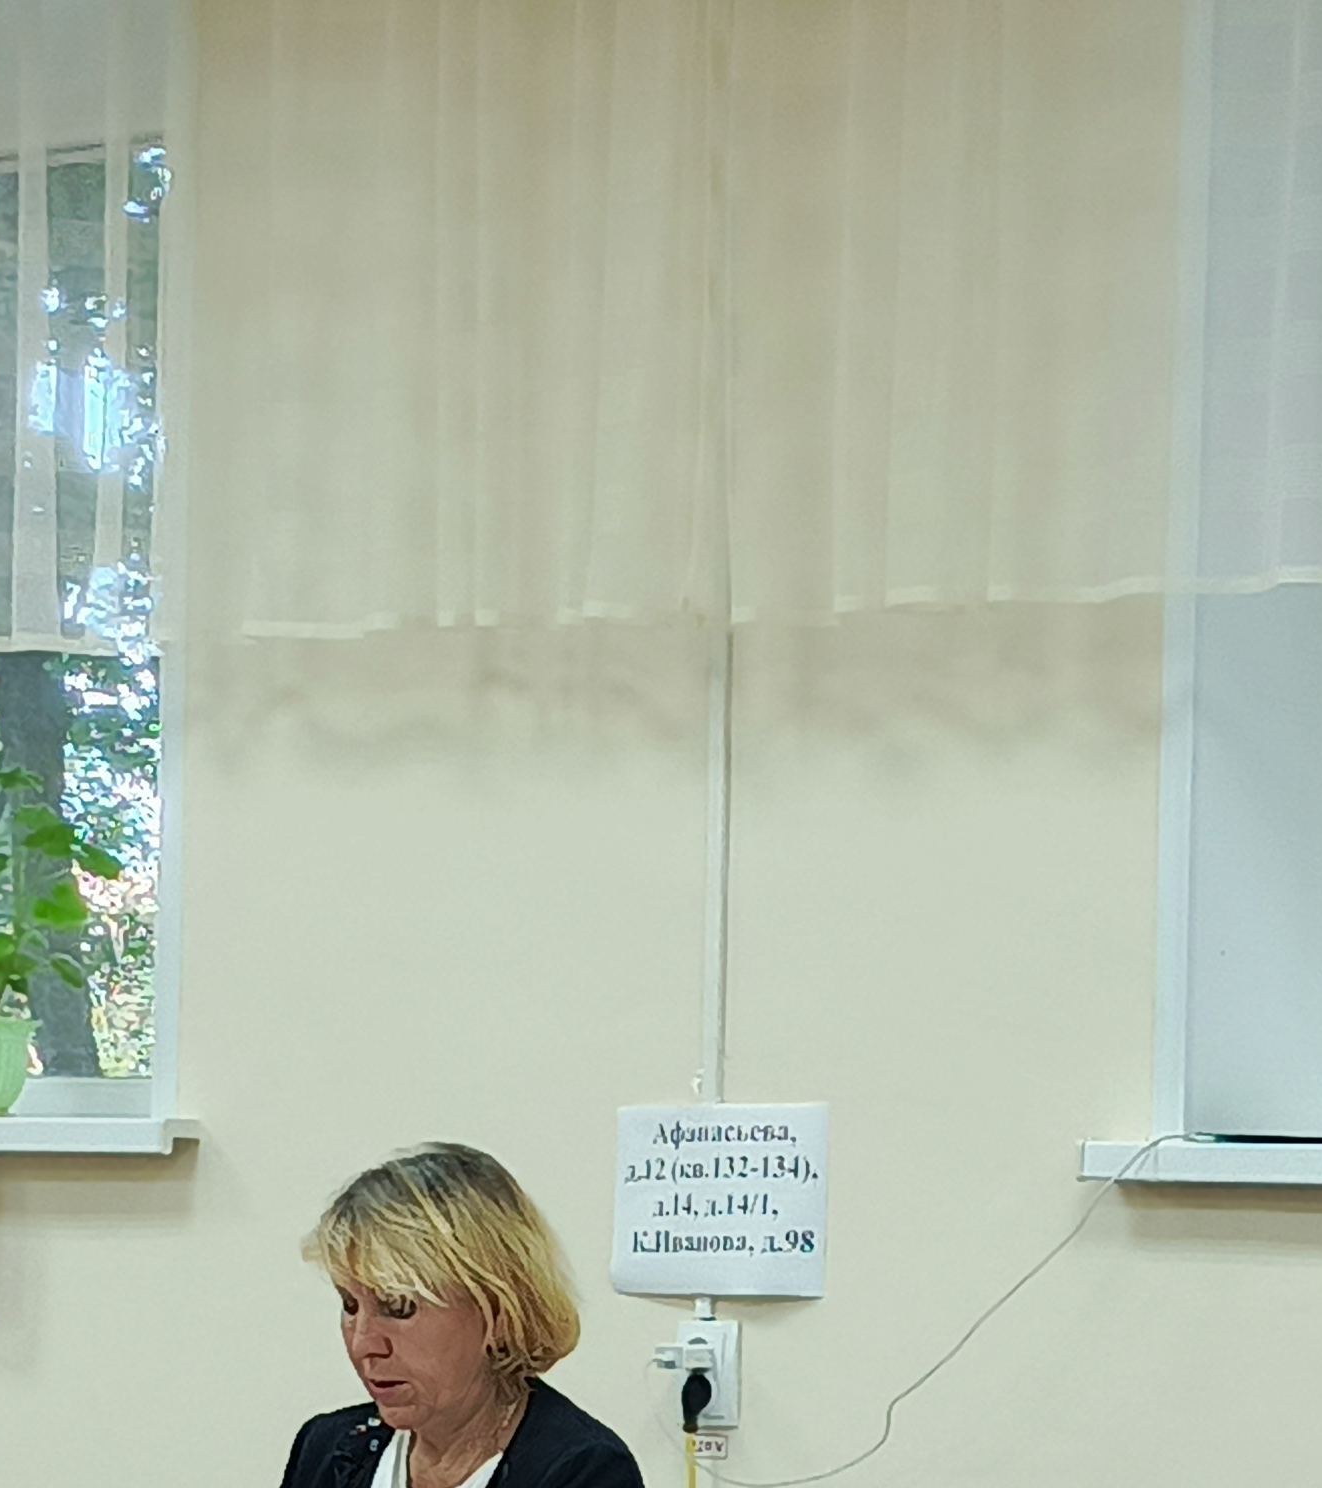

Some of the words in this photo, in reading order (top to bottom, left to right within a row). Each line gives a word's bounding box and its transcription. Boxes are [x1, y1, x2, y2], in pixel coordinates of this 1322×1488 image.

[652, 1120, 797, 1150] Афанасьева,
[653, 1192, 699, 1221] д.14,
[703, 1192, 779, 1221] д.14/1,
[760, 1229, 815, 1253] д.98
